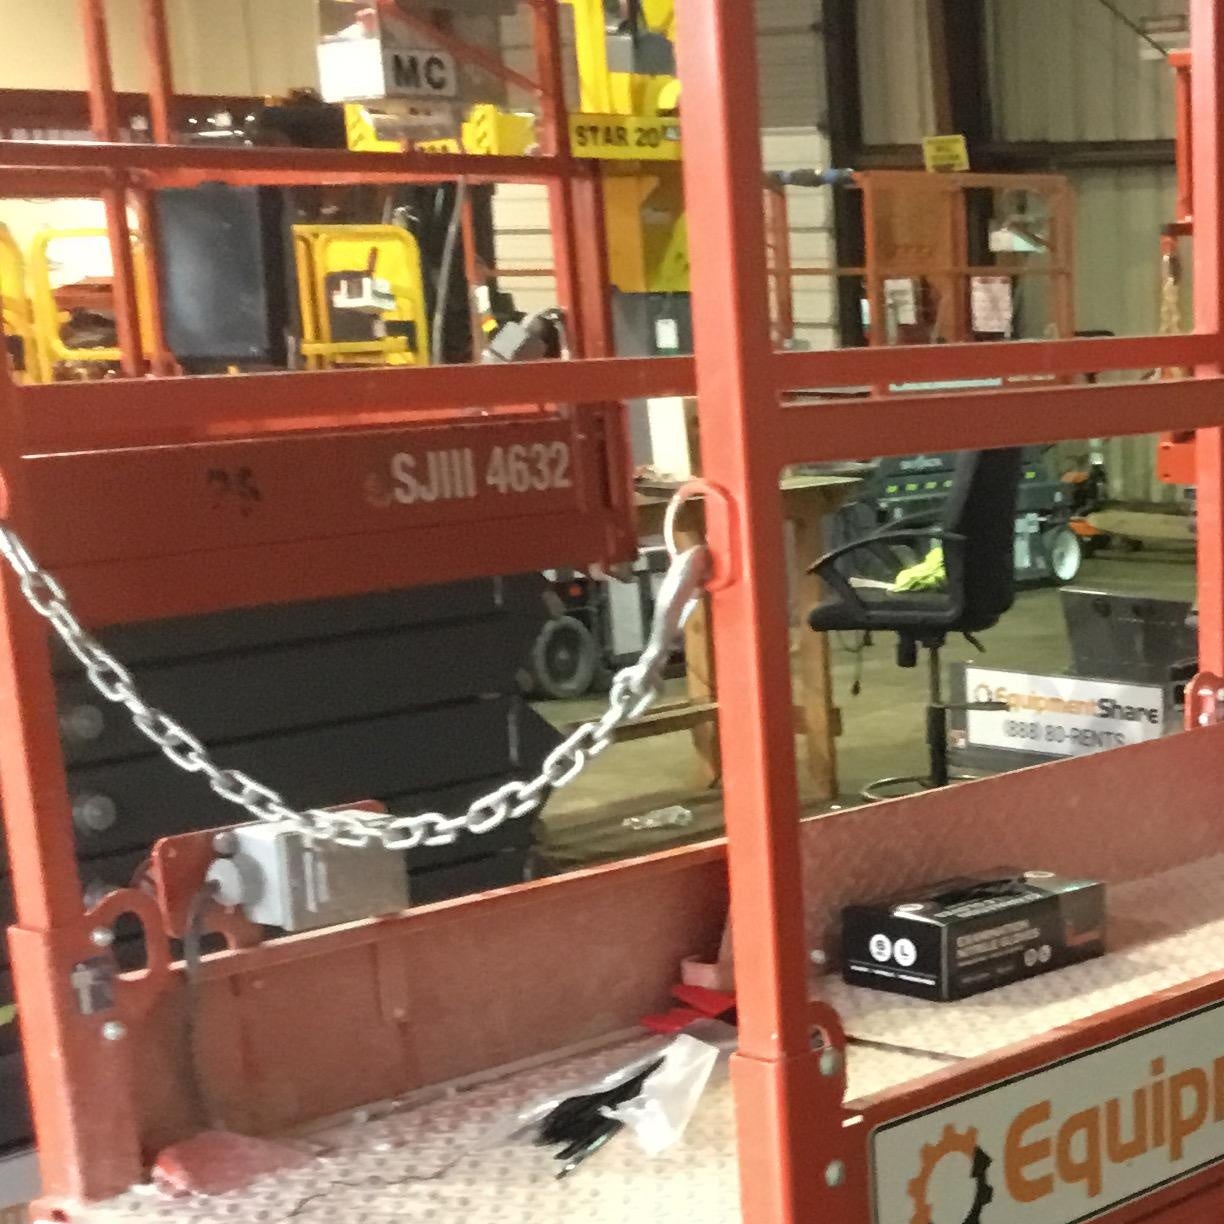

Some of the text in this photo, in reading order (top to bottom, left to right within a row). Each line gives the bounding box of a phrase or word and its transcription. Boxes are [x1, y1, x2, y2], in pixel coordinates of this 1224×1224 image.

[393, 54, 446, 90] MC
[576, 125, 628, 147] STAR
[485, 441, 572, 493] 4632
